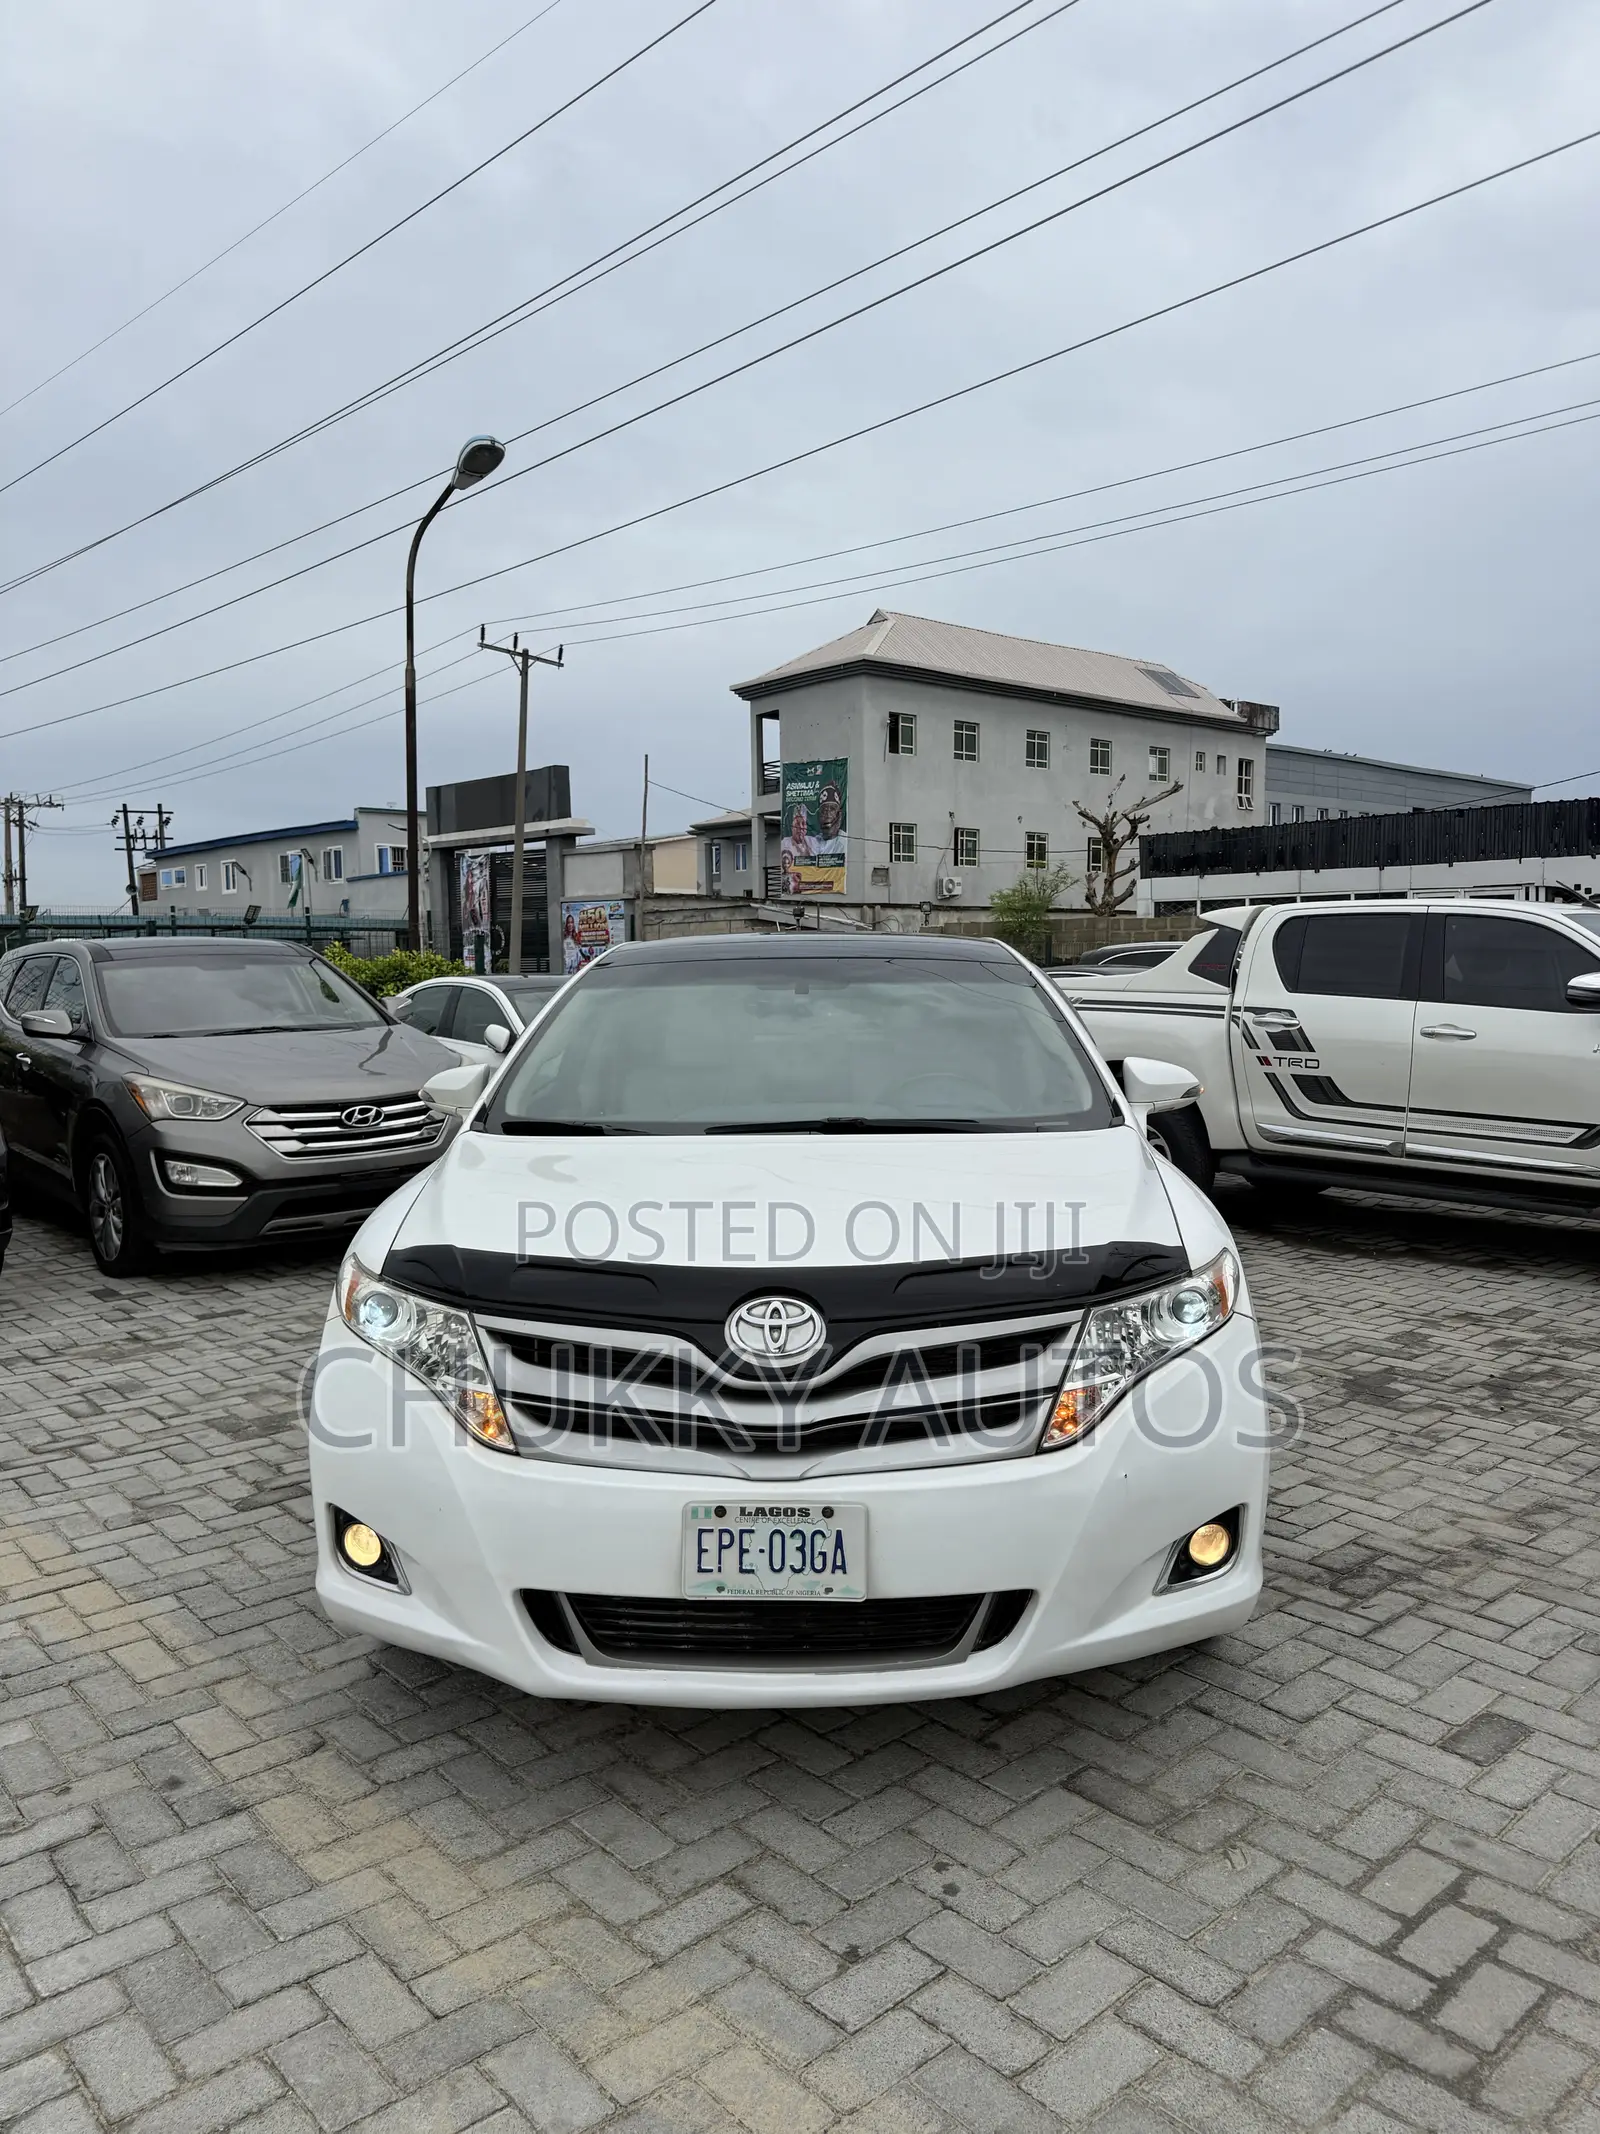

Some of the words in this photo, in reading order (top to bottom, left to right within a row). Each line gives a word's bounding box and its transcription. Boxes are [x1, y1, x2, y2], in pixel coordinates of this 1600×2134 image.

[786, 789, 814, 797] SHETTIMA
[579, 922, 609, 931] MILLION
[1273, 1056, 1320, 1070] TRD
[739, 1506, 811, 1518] LAGOS
[734, 1516, 760, 1524] CENTRE
[773, 1517, 816, 1525] EXCELLENCE
[697, 1528, 848, 1575] EPE-03GA
[756, 1588, 785, 1596] REPUBLIC
